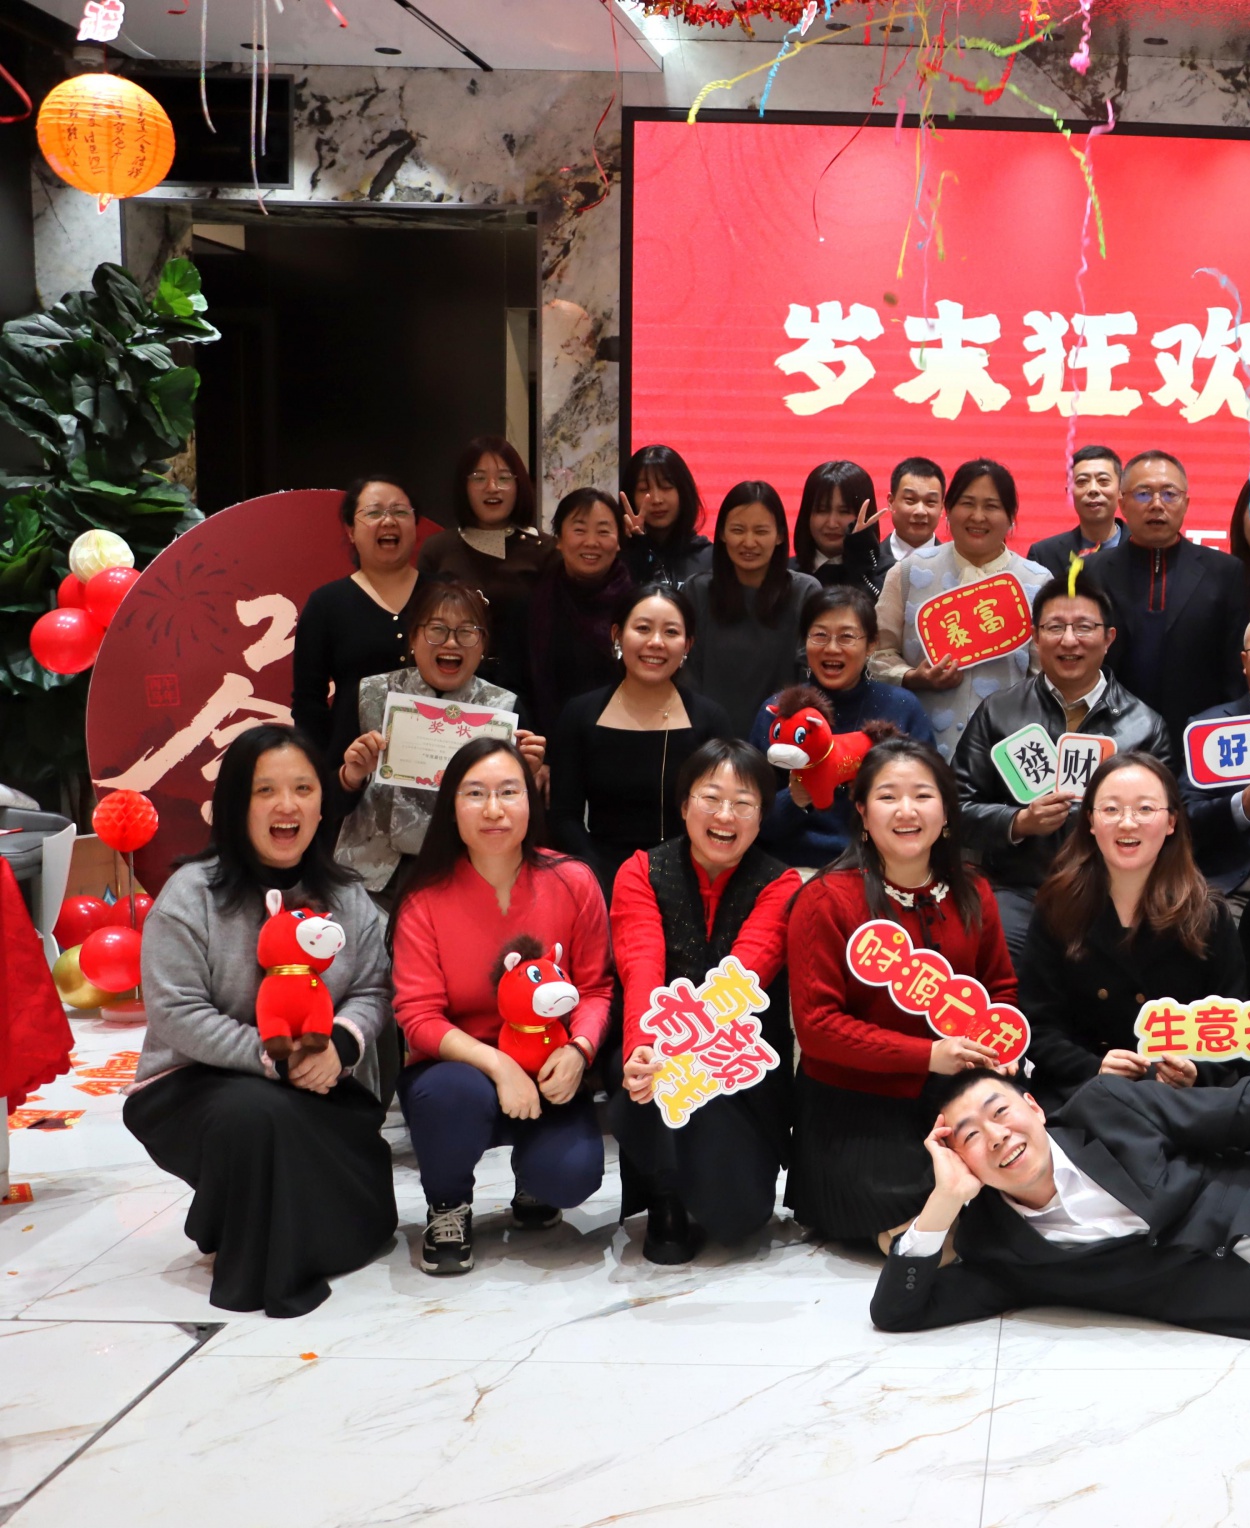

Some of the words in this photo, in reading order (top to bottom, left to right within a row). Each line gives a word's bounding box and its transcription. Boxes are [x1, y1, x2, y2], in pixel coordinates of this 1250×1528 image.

[939, 598, 1005, 649] 暴富
[428, 720, 472, 739] 奖状
[856, 928, 1024, 1053] 财源广进
